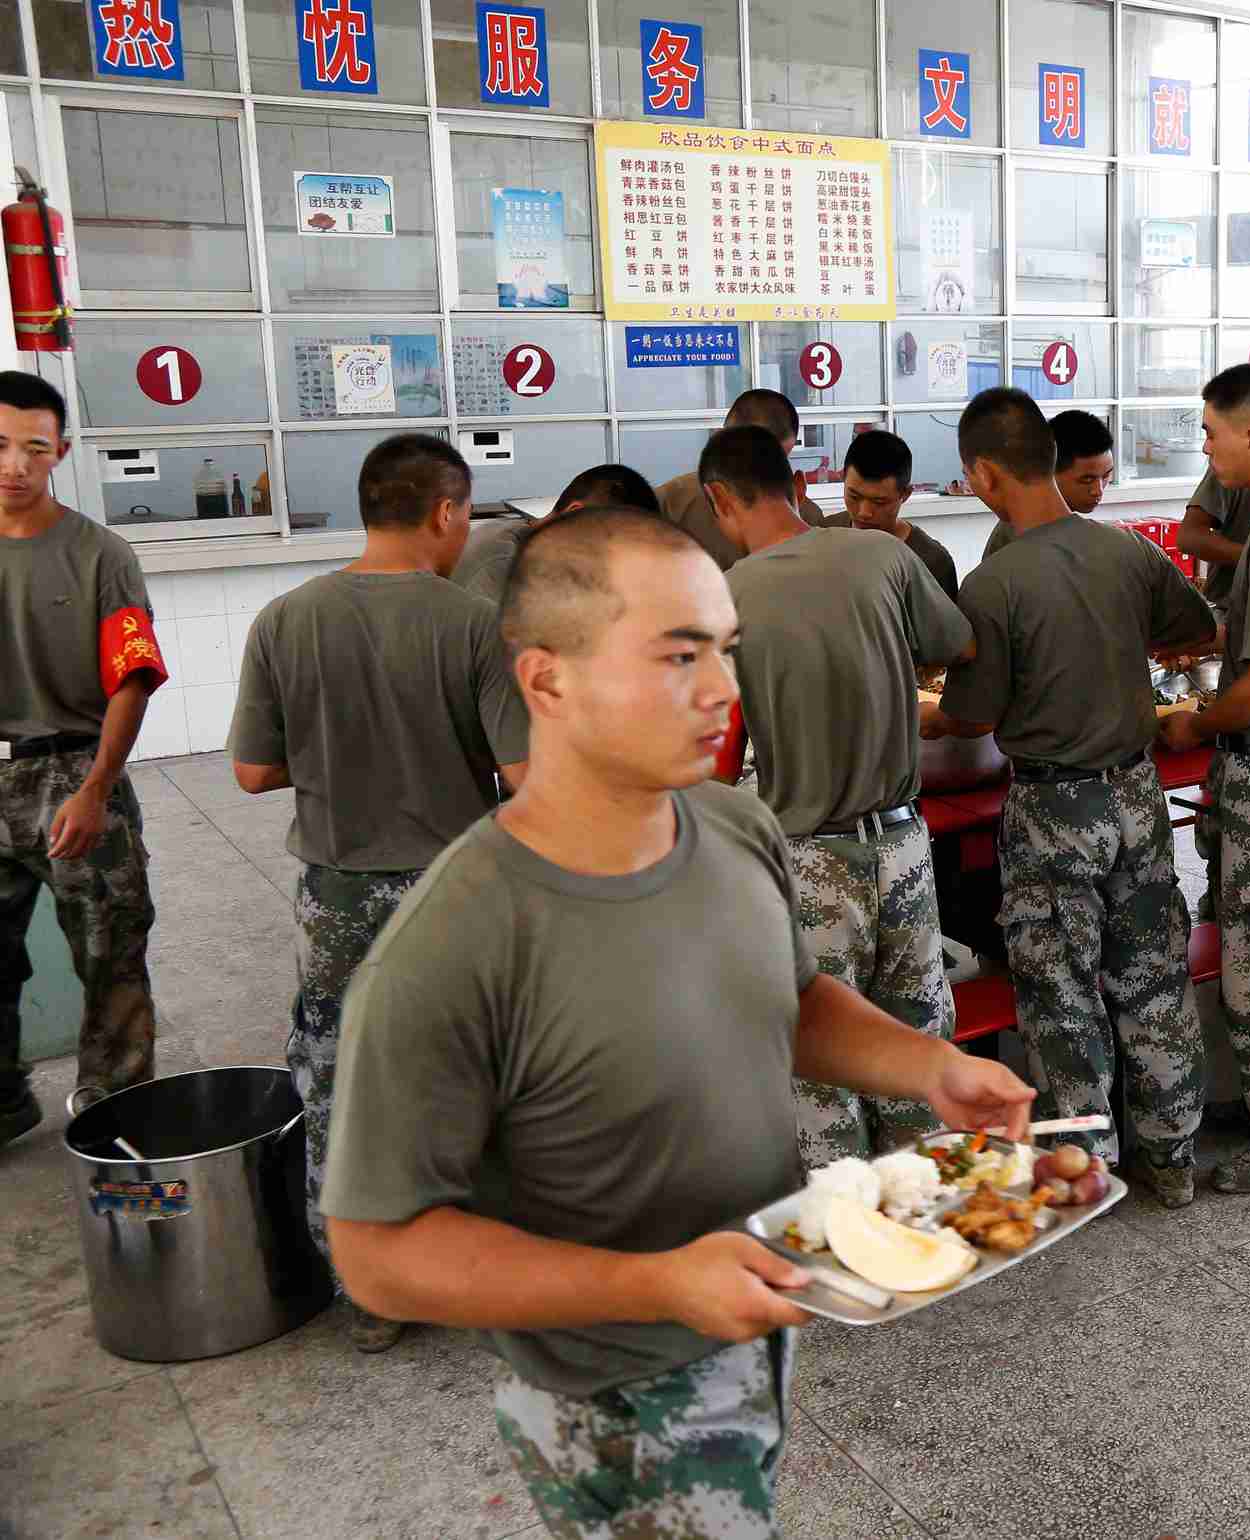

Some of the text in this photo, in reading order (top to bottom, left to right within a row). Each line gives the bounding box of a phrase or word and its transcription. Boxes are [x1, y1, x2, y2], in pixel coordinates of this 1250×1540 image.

[658, 129, 837, 157] 欣品饮食中式面点
[620, 158, 686, 174] 鲜肉灌汤包
[710, 164, 792, 180] 香辣粉丝饼
[621, 176, 687, 191] 青菜香菇包
[817, 169, 871, 184] 刀切白馒头
[326, 182, 378, 195] 互帮互让
[711, 181, 792, 197] 鸡蛋千层饼
[309, 195, 363, 210] 团结友爱
[623, 193, 688, 208] 香辣粉丝包
[712, 198, 793, 213] 葱花千层饼
[624, 210, 688, 225] 相思红豆包
[712, 215, 793, 230] 酱香千层饼
[625, 229, 689, 241] 红豆饼
[713, 232, 794, 246] 红枣千层饼
[818, 227, 872, 240] 白米稀饭
[625, 246, 689, 259] 鲜肉饼
[714, 248, 794, 262] 特色大麻饼
[626, 263, 690, 276] 香菇菜饼
[714, 265, 795, 279] 香甜南瓜饼
[627, 281, 690, 293] 一品酥饼
[715, 281, 797, 295] 农家饼大众风味
[632, 353, 682, 363] APPRECIATE
[686, 352, 707, 362] YOUR
[1049, 344, 1071, 383] 4
[515, 350, 543, 395] 2
[810, 345, 832, 388] 3
[155, 351, 182, 400] 1
